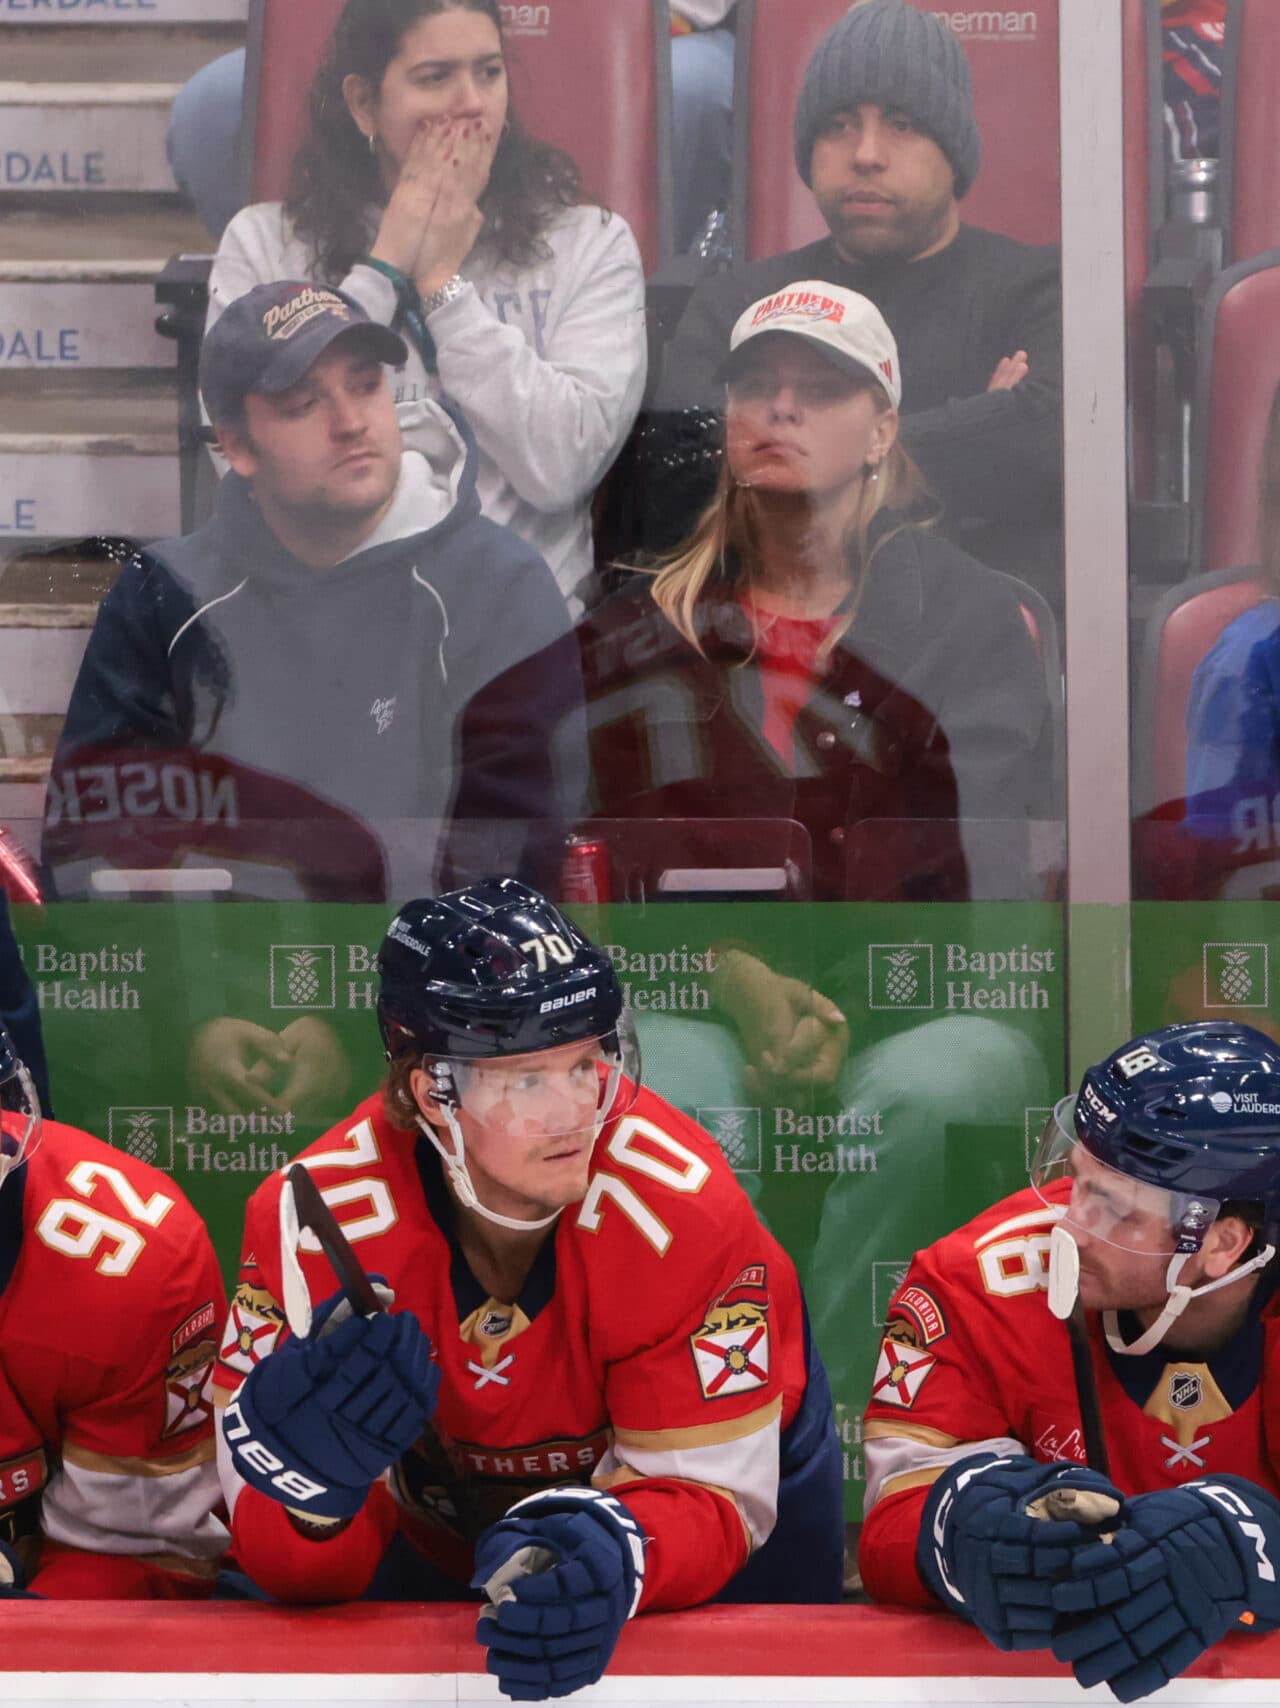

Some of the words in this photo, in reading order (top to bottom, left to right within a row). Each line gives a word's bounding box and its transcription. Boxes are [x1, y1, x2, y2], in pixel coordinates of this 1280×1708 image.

[36, 944, 146, 981] Baptist
[520, 934, 576, 973] 70
[945, 943, 1056, 980] Baptist
[36, 981, 142, 1009] Health
[539, 987, 598, 1015] BAUER
[945, 981, 1050, 1009] Health
[1116, 1045, 1159, 1079] 18
[1084, 1082, 1118, 1124] CCM
[1233, 1093, 1259, 1104] VISIT
[185, 1105, 296, 1143] Baptist
[772, 1107, 884, 1143] Baptist
[186, 1142, 290, 1171] Health
[773, 1143, 878, 1172] Health
[576, 1115, 712, 1258] 70
[34, 1159, 177, 1278] 92
[973, 1203, 1072, 1298] 18
[903, 1290, 940, 1333] FLORIDA
[467, 1446, 597, 1474] THERS
